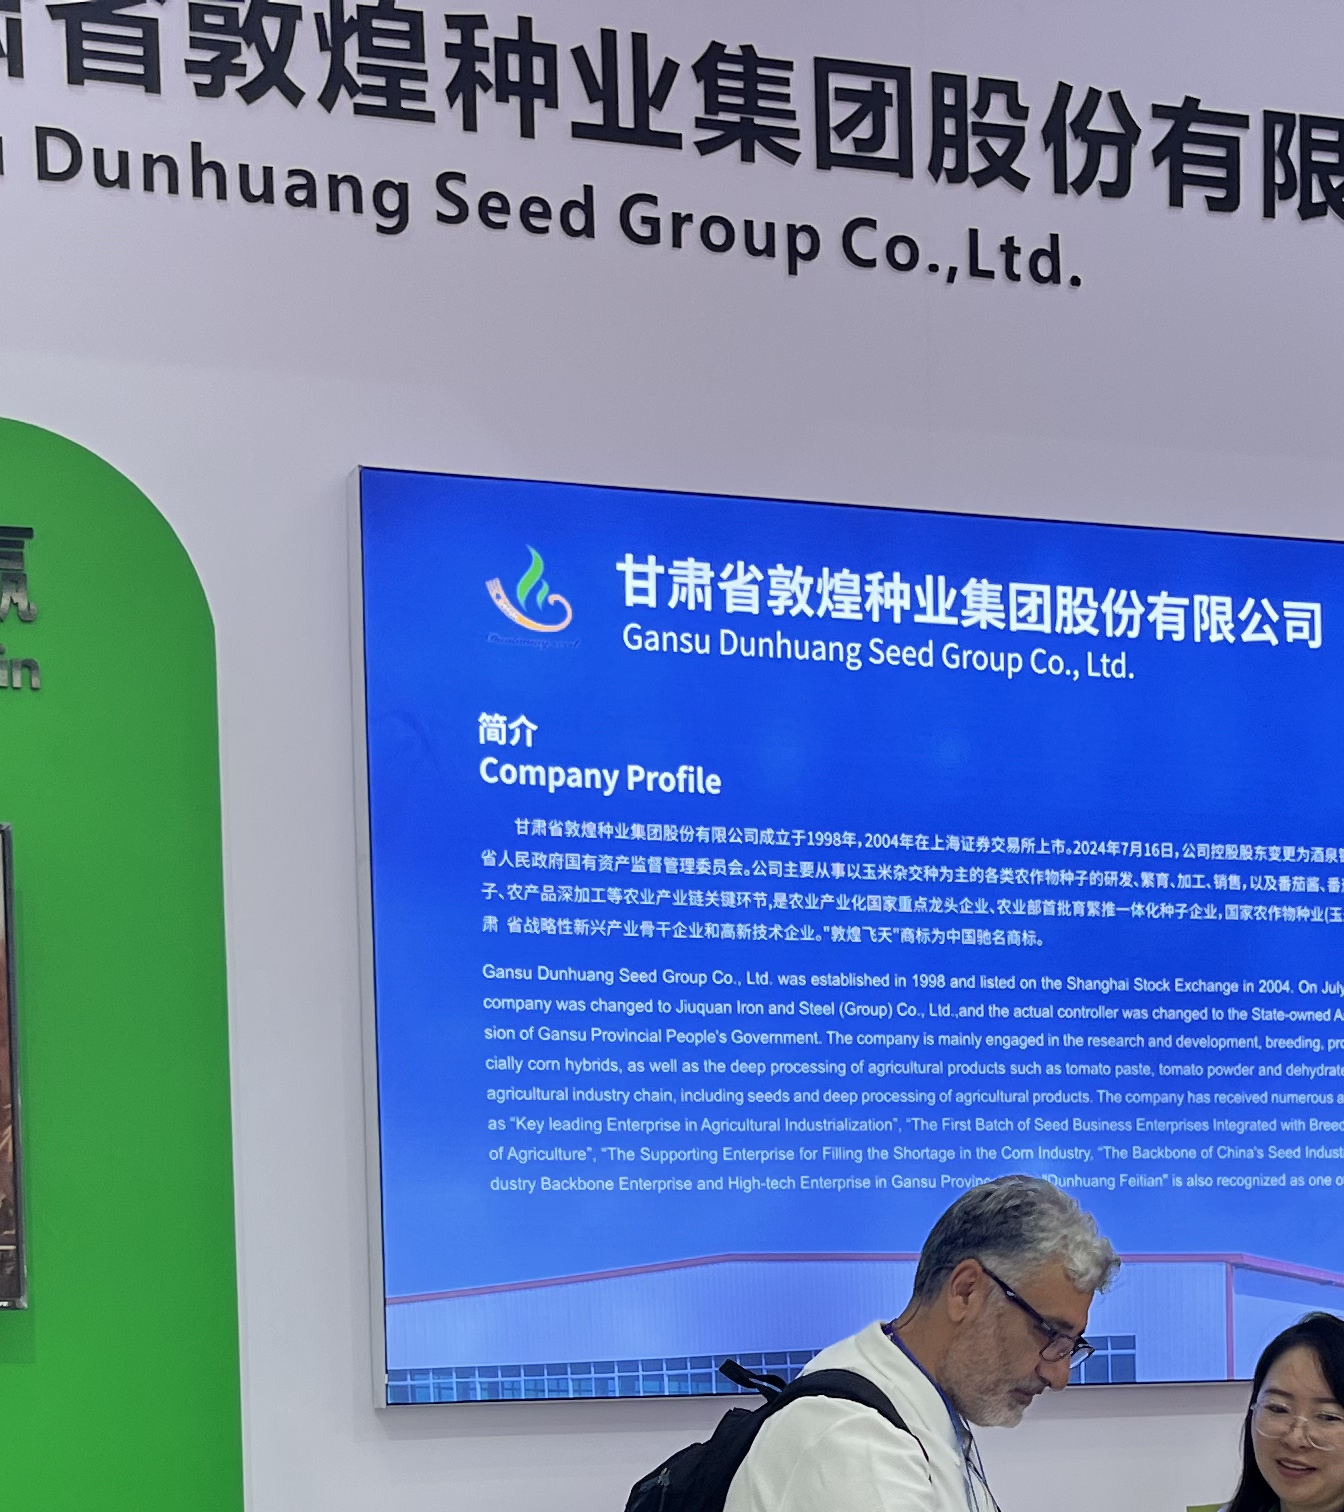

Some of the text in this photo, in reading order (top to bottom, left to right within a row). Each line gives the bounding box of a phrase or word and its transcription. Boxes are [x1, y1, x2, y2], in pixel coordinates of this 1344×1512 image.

[34, 125, 412, 235] Dunhuang
[434, 171, 596, 240] Seed
[619, 192, 821, 276] Group
[616, 553, 1324, 650] 甘肃省敦煌种业集团股份有限公司
[623, 623, 1135, 681] Gansu Dunhuang Seed Group Co., Ltd.
[477, 711, 539, 748] 简介
[479, 757, 722, 797] Company Profile
[481, 963, 533, 980] Gansu
[537, 965, 615, 986] Dunhuang
[618, 967, 658, 983] Seed
[661, 968, 708, 987] Group
[776, 974, 807, 986] was
[810, 972, 891, 988] established
[893, 973, 907, 987] in
[911, 973, 947, 989] 1998
[949, 974, 976, 989] and
[979, 974, 1016, 990] listed
[1019, 978, 1038, 990] on
[1040, 975, 1063, 990] the
[1066, 976, 1130, 994] Shanghai
[1133, 976, 1171, 992] Stock
[1174, 977, 1240, 996] Exchange
[1242, 979, 1255, 993] in
[1297, 979, 1319, 994] On
[482, 998, 553, 1015] company
[555, 999, 587, 1012] was
[589, 997, 654, 1017] changed
[657, 1000, 673, 1014] to
[675, 999, 733, 1017] Jiuquan
[736, 999, 765, 1015] Iron
[767, 1001, 795, 1015] and
[798, 1000, 836, 1016] Steel
[987, 1003, 1010, 1018] the
[1012, 1004, 1054, 1019] actual
[1056, 1004, 1120, 1020] controller
[1121, 1008, 1150, 1020] was
[1151, 1006, 1209, 1024] changed
[1211, 1008, 1225, 1021] to
[1227, 1007, 1249, 1021] the
[483, 1024, 516, 1040] sion
[518, 1025, 535, 1041] of
[537, 1025, 587, 1042] Gansu
[590, 1027, 663, 1043] Provincial
[825, 1030, 854, 1045] The
[856, 1034, 921, 1049] company
[922, 1032, 935, 1046] is
[937, 1032, 983, 1049] mainly
[984, 1032, 1045, 1050] engaged
[1047, 1032, 1060, 1046] in
[1062, 1032, 1085, 1047] the
[1087, 1034, 1145, 1048] research
[1147, 1034, 1173, 1048] and
